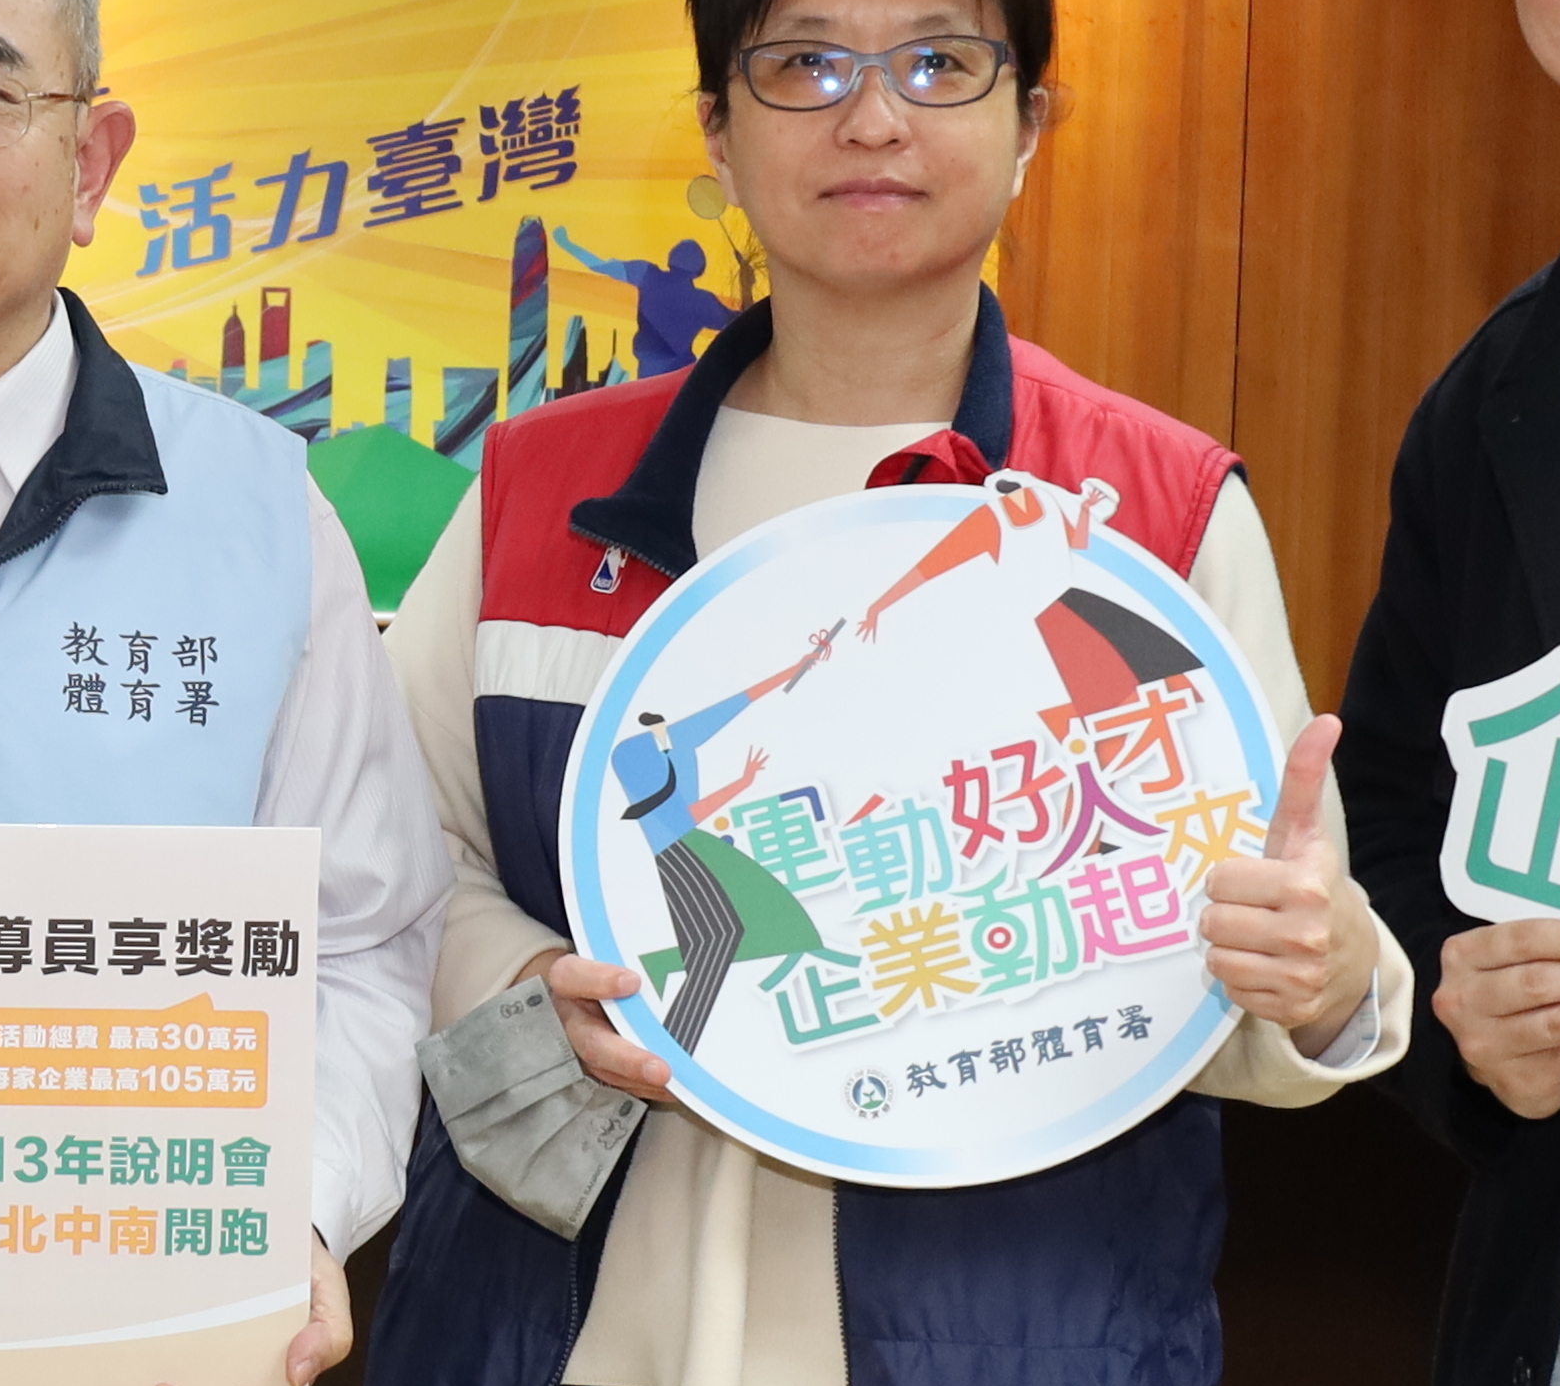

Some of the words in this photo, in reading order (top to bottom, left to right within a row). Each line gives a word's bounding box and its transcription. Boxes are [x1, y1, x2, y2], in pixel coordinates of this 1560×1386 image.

[135, 83, 582, 278] 活力臺灣
[61, 622, 218, 674] 教育部
[61, 673, 219, 727] 體育署
[711, 688, 1200, 915] 運動好人才
[758, 790, 1267, 1044] 企業動起來
[109, 1024, 258, 1052] 最高30萬元
[906, 1004, 1154, 1098] 教育部體育署
